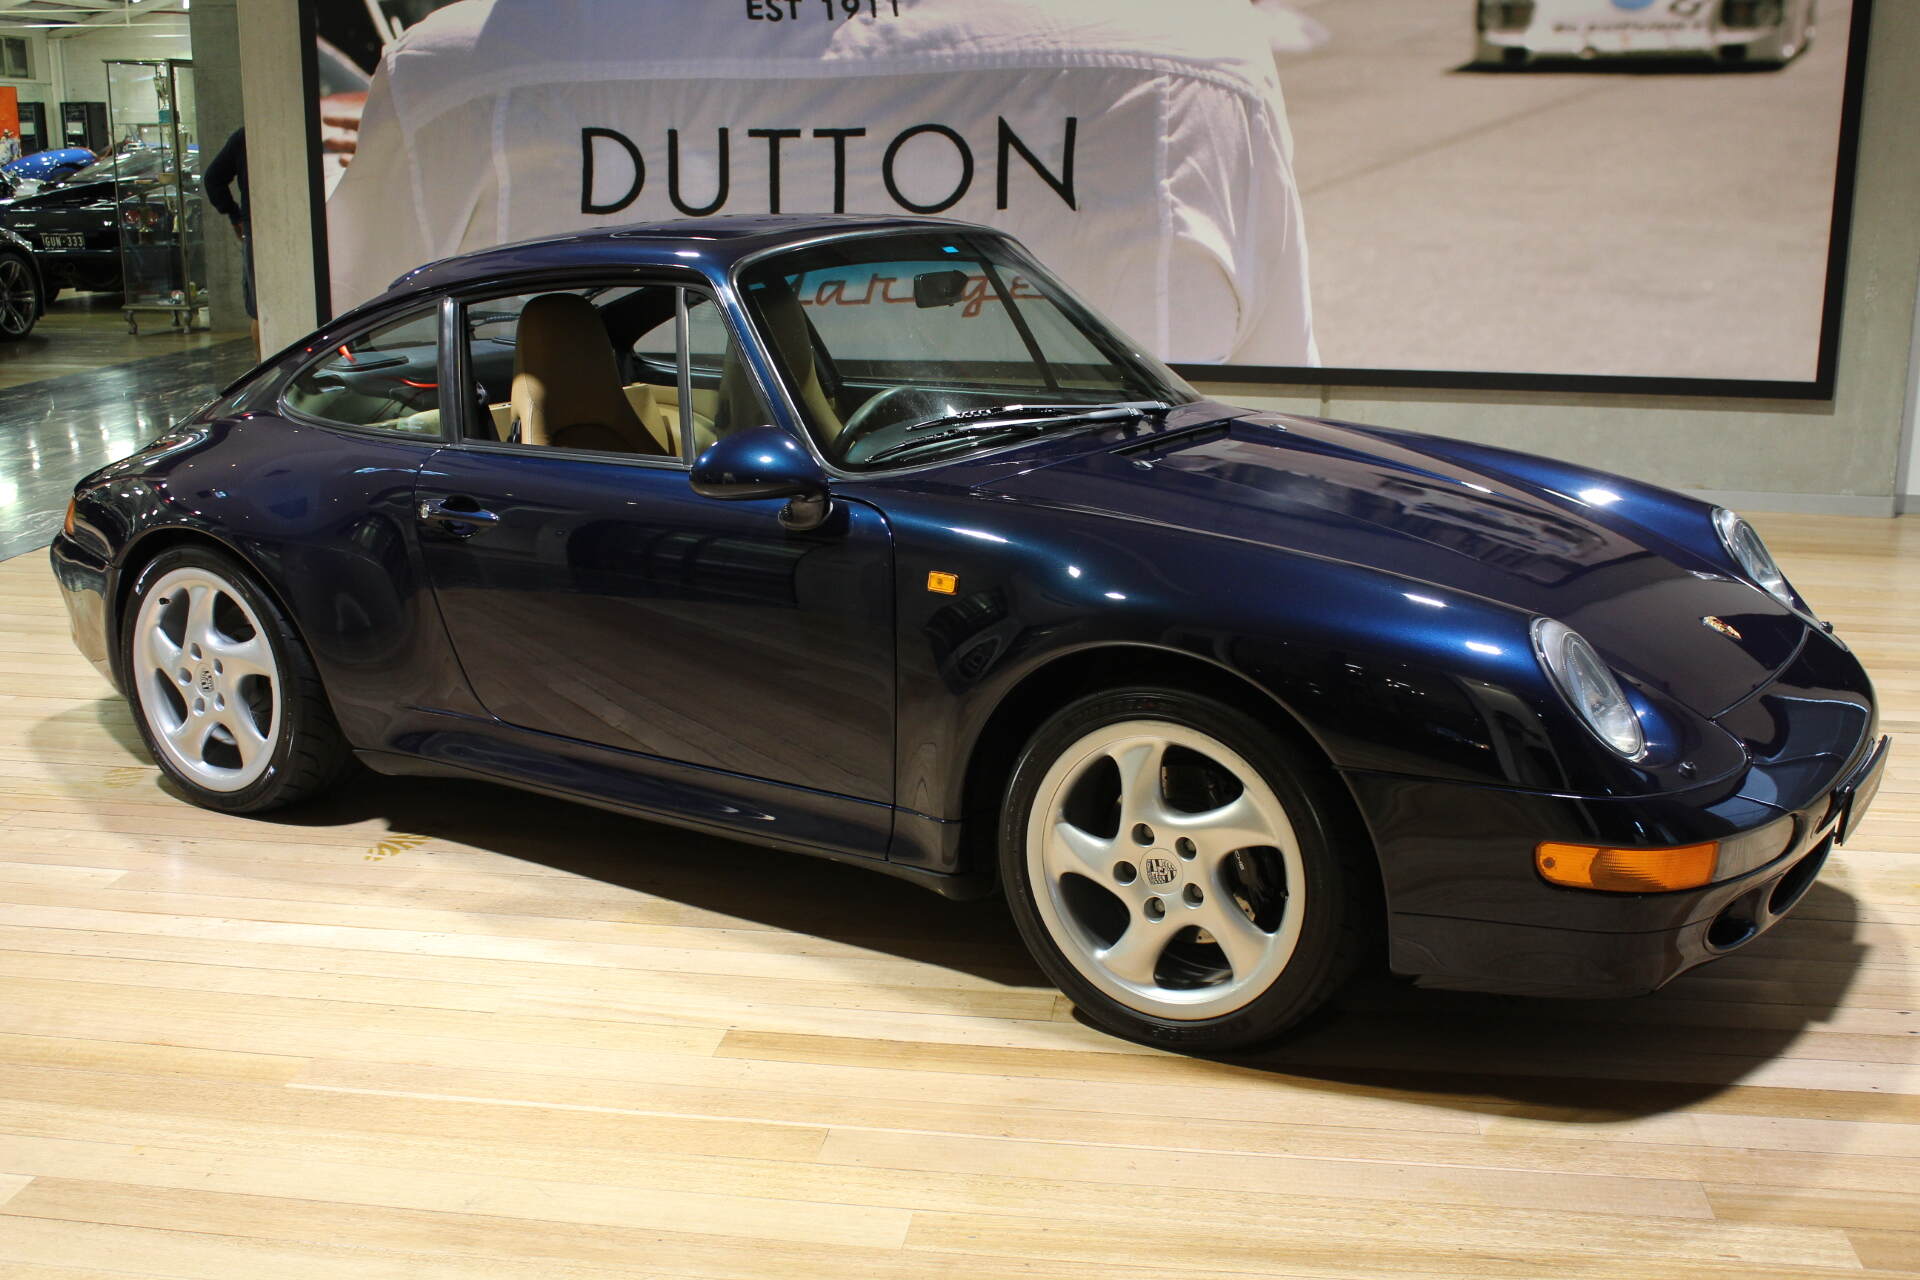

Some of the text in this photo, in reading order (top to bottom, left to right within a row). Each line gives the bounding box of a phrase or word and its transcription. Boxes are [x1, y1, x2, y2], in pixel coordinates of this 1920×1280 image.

[746, 0, 899, 22] EST 1911
[580, 115, 1079, 217] DUTTON
[799, 272, 1049, 318] arge
